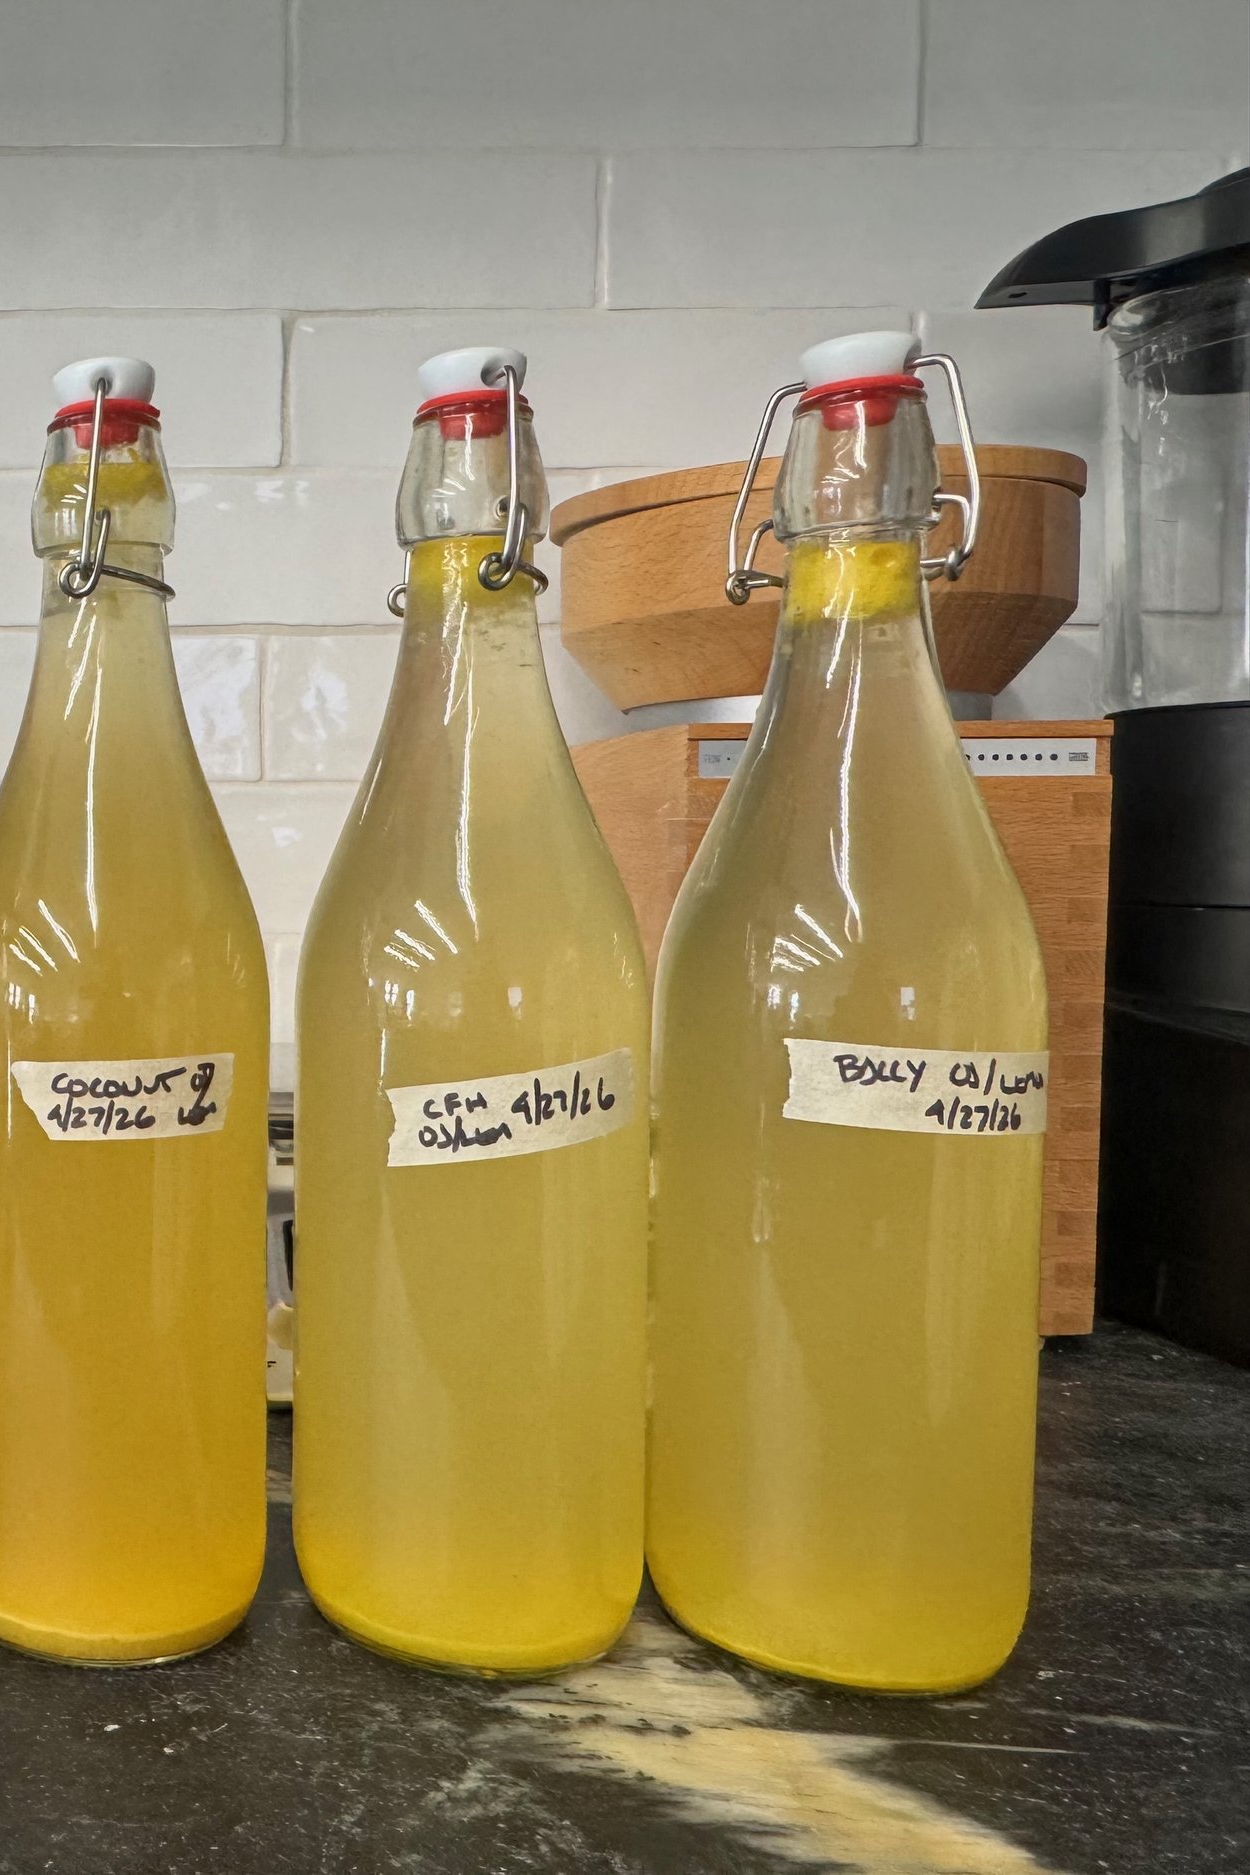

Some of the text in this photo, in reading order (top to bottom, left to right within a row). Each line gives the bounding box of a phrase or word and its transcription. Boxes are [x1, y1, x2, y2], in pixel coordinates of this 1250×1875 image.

[51, 1066, 187, 1099] COCONUT
[422, 1070, 615, 1126] CFH 4/27/26
[47, 1099, 156, 1135] 4/27/26
[924, 1096, 1022, 1133] 4/27/26
